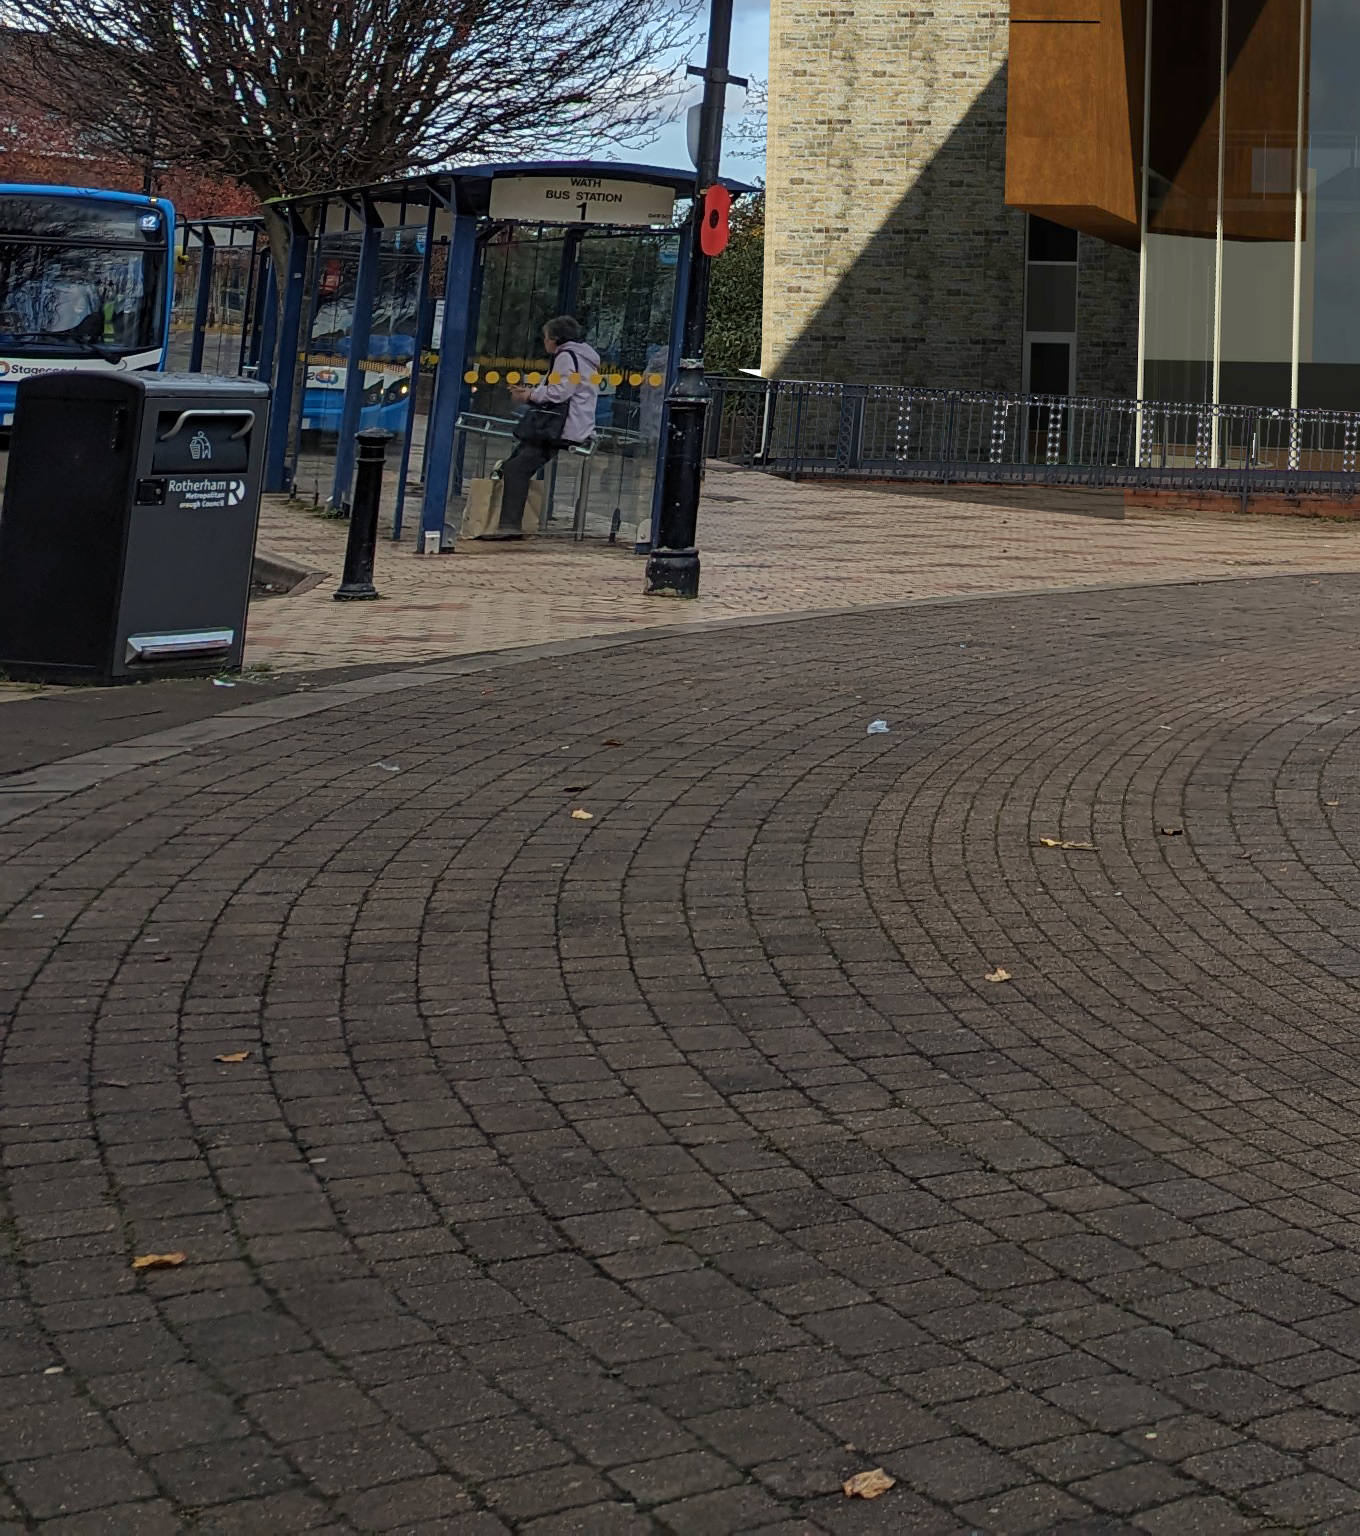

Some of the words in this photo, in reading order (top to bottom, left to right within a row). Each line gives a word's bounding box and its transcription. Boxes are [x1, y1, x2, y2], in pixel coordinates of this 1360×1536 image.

[570, 177, 602, 188] WATH
[545, 189, 570, 200] BUS
[575, 191, 623, 203] STATION
[576, 202, 588, 221] 1
[168, 479, 227, 492] Rotherham
[185, 492, 225, 500] Metropolitan
[201, 499, 225, 508] Council
